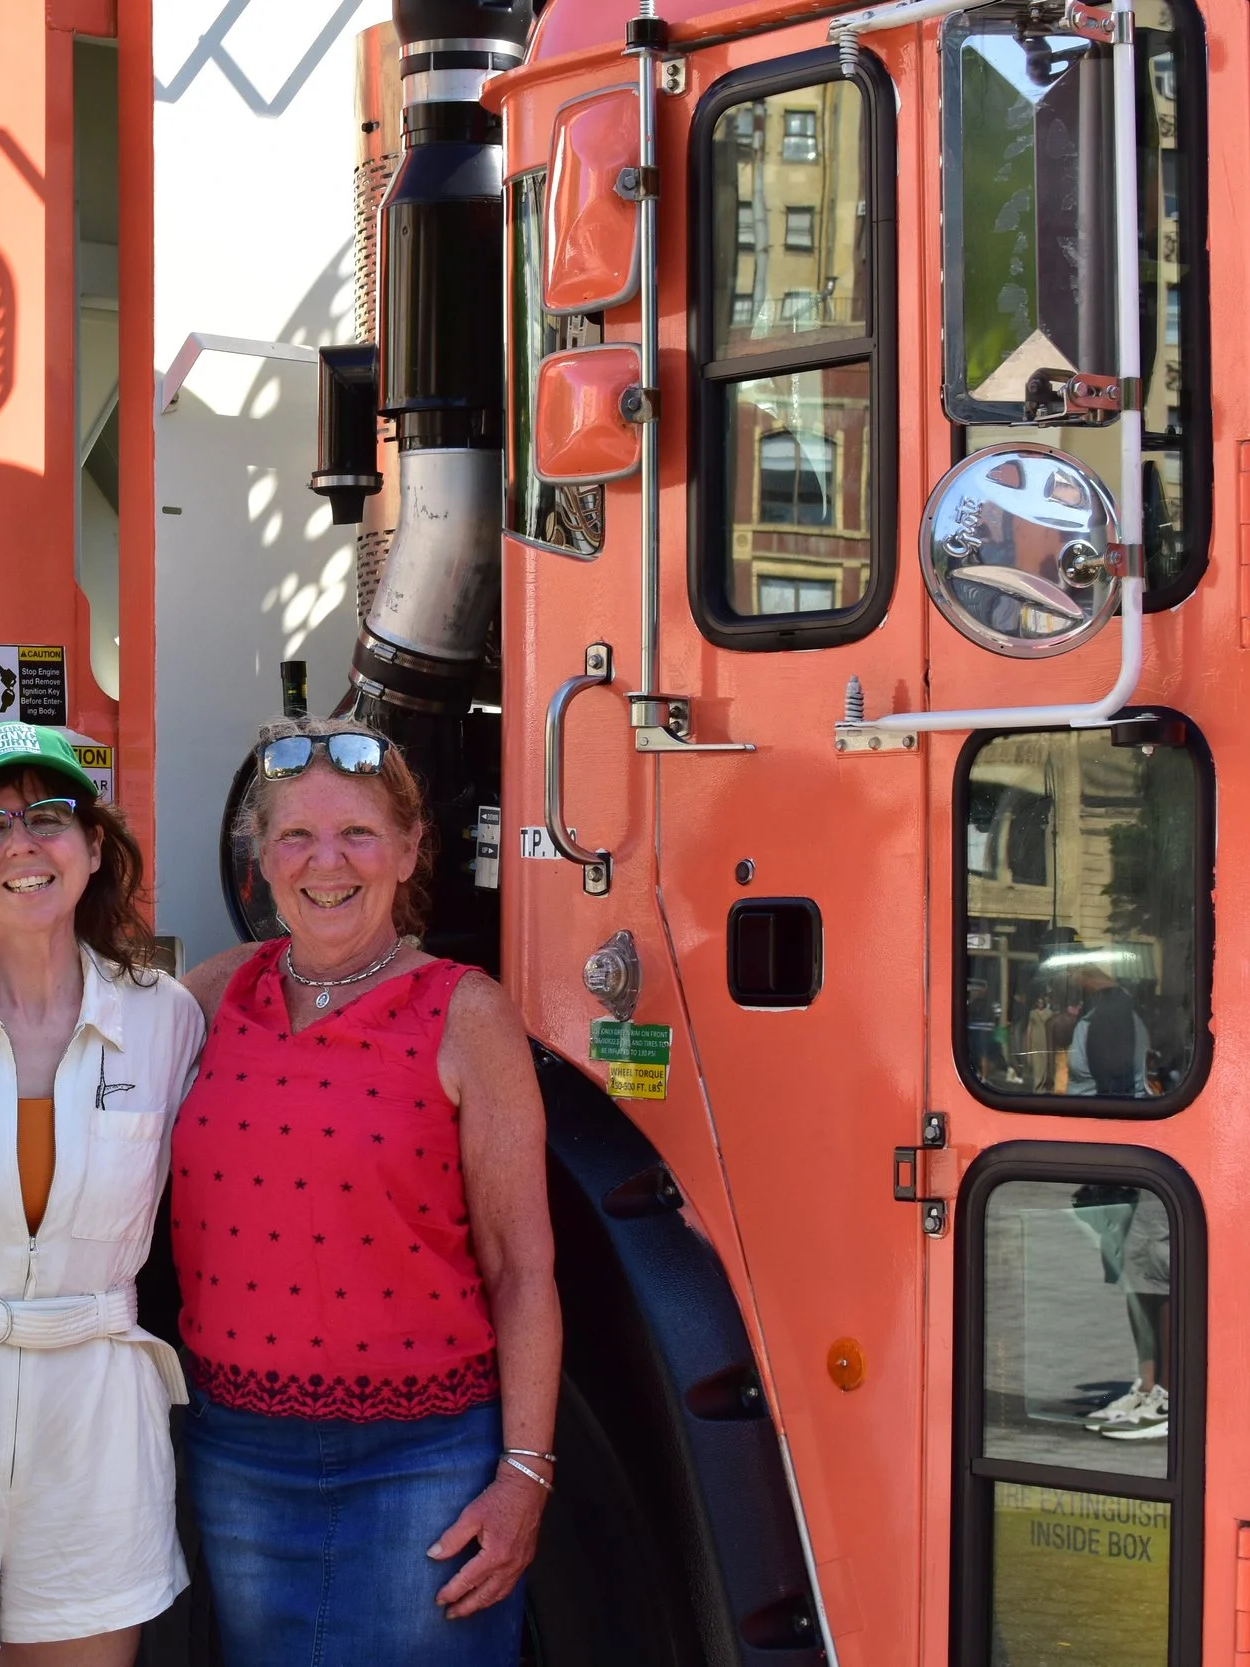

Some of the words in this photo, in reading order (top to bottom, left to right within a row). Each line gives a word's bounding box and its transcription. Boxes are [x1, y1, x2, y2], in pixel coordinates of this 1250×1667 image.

[27, 651, 61, 659] CAUTION
[21, 668, 37, 677] Stop
[38, 668, 60, 677] Engine
[22, 688, 47, 698] Ignition
[48, 688, 60, 696] Key
[27, 708, 37, 716] ing
[39, 707, 57, 716] Body.
[7, 731, 37, 740] NYC
[611, 1067, 633, 1076] WHEEL
[635, 1069, 664, 1079] TORQUE
[637, 1083, 647, 1091] FT.
[648, 1083, 663, 1093] LBS.
[1030, 1519, 1100, 1555] INSIDE
[1108, 1531, 1152, 1563] BOX
